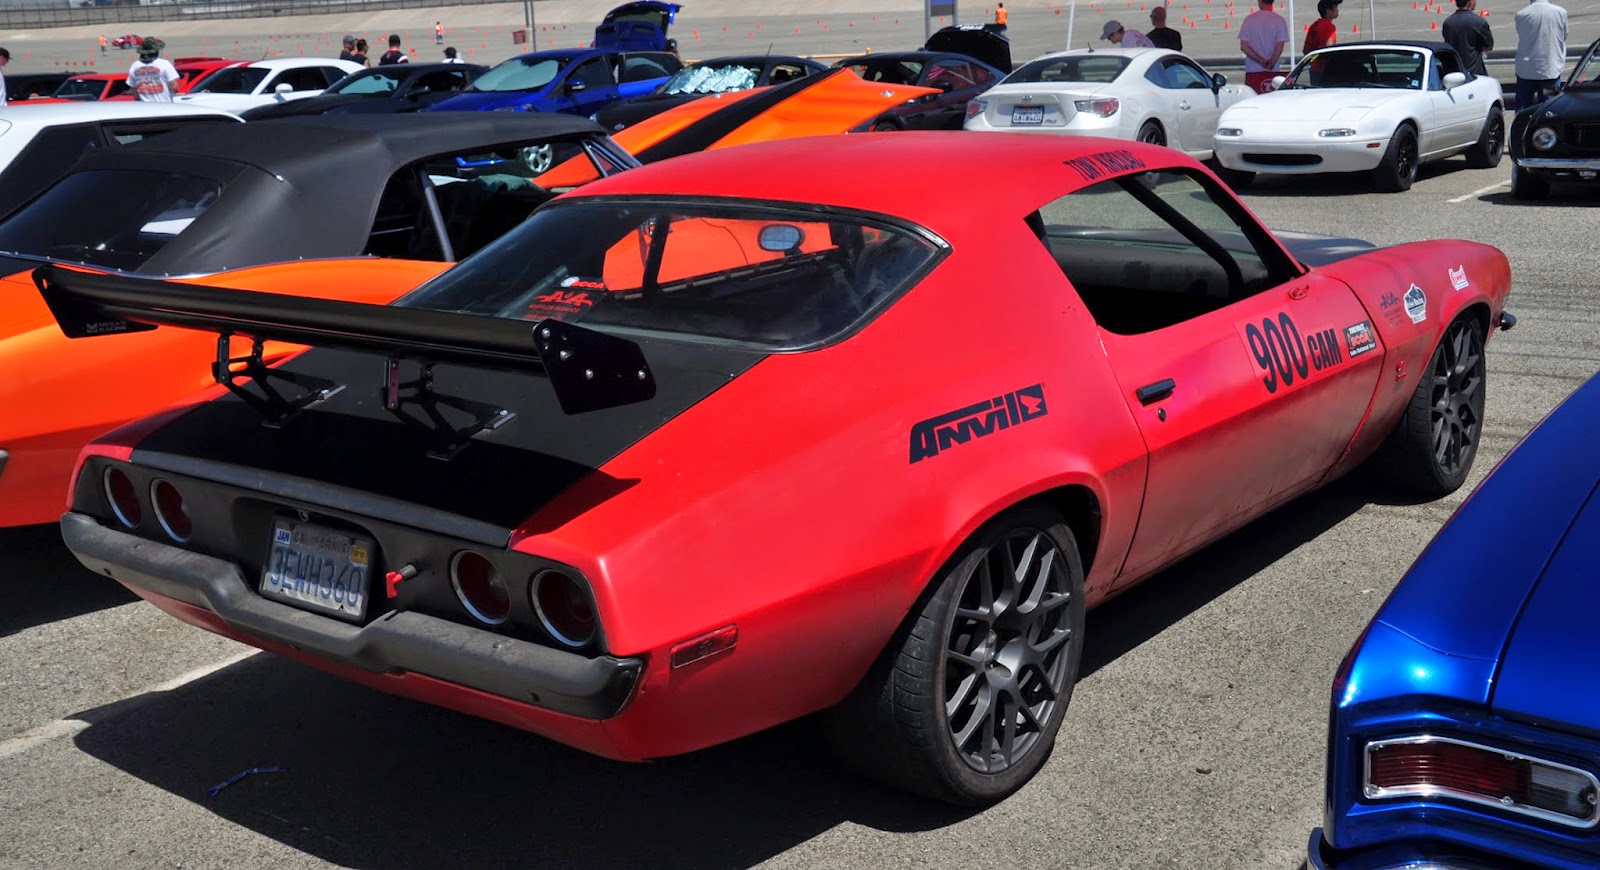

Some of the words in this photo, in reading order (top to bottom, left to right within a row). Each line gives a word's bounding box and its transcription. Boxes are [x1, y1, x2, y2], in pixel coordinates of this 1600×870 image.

[1062, 156, 1107, 181] TONY
[1245, 311, 1308, 394] 900
[1306, 328, 1343, 371] CAM
[277, 530, 290, 542] JAN
[293, 531, 350, 553] CALIFORNIA
[270, 547, 362, 607] 3EWH360
